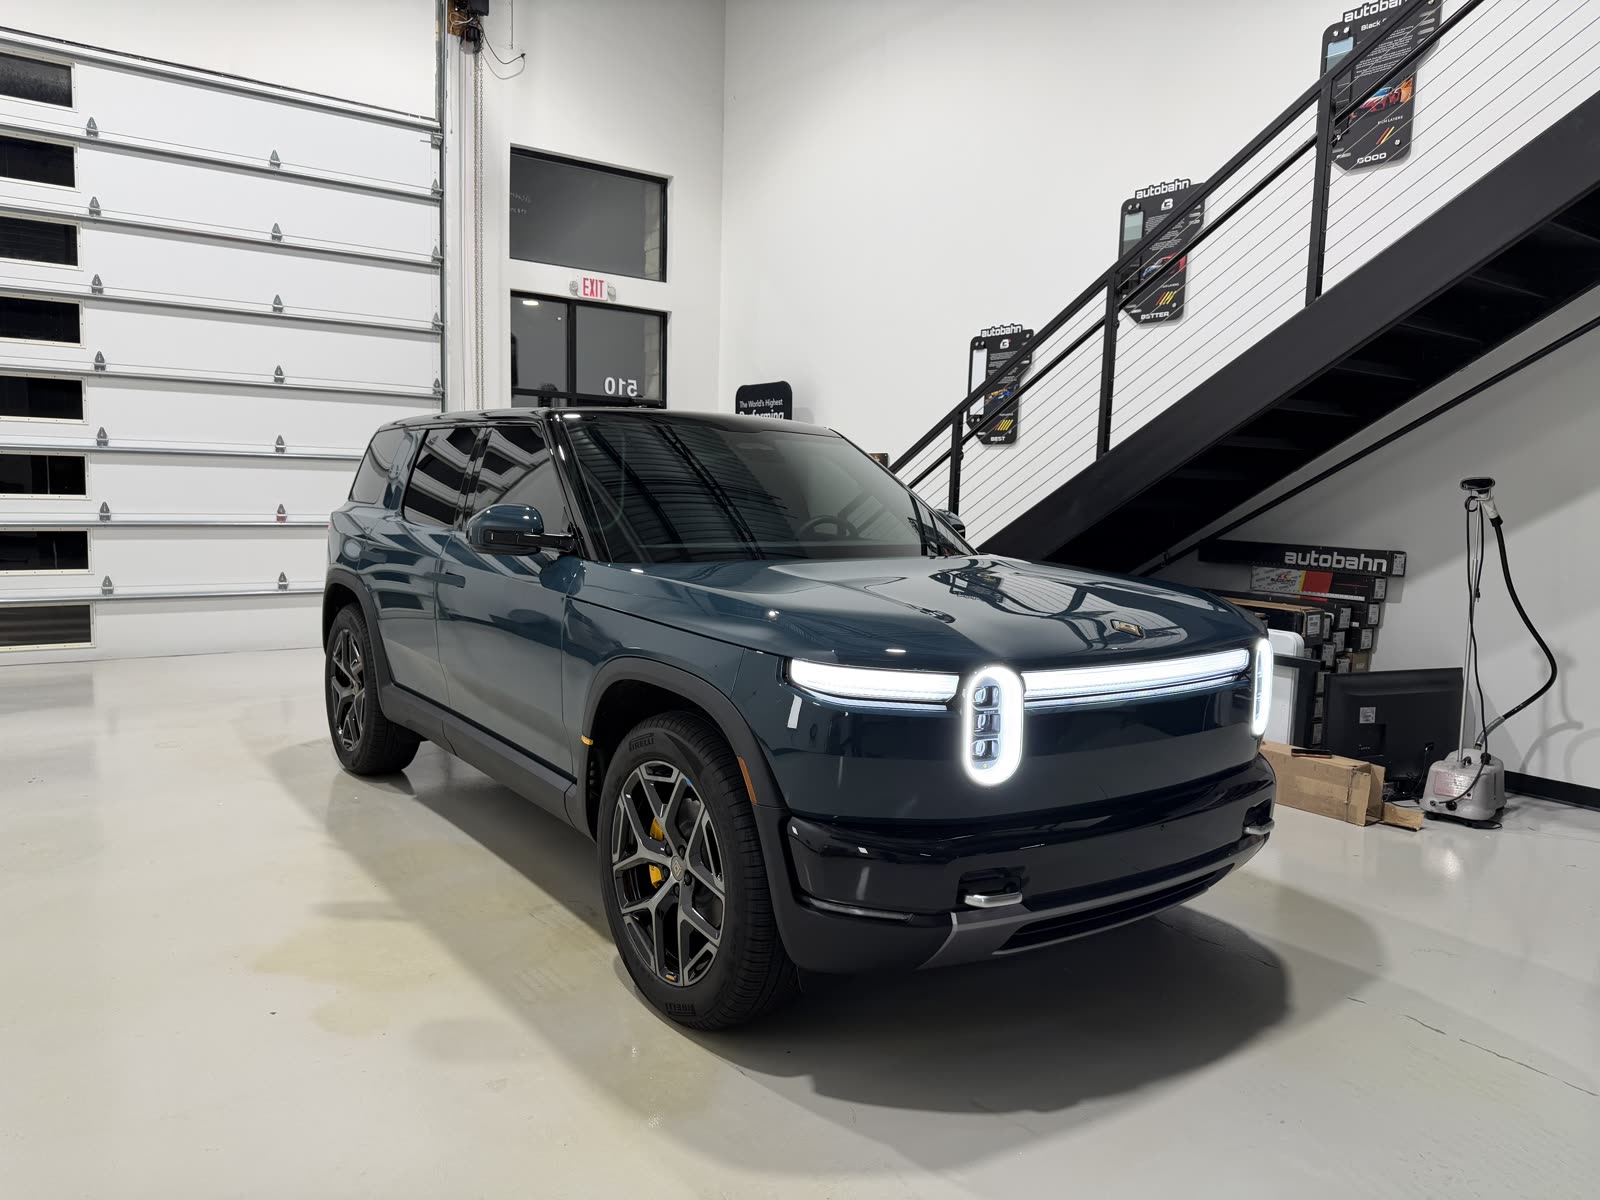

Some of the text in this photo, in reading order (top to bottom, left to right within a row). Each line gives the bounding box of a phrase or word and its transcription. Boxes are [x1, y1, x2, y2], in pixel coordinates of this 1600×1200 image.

[1361, 20, 1381, 31] Black
[1357, 152, 1387, 164] GOOD
[1136, 179, 1190, 199] autobahn
[583, 277, 605, 298] EXIT
[981, 324, 1022, 338] autobahn
[740, 400, 748, 408] The
[765, 398, 784, 408] Highest
[1284, 550, 1387, 573] autobahn
[628, 733, 655, 752] PIRELLI
